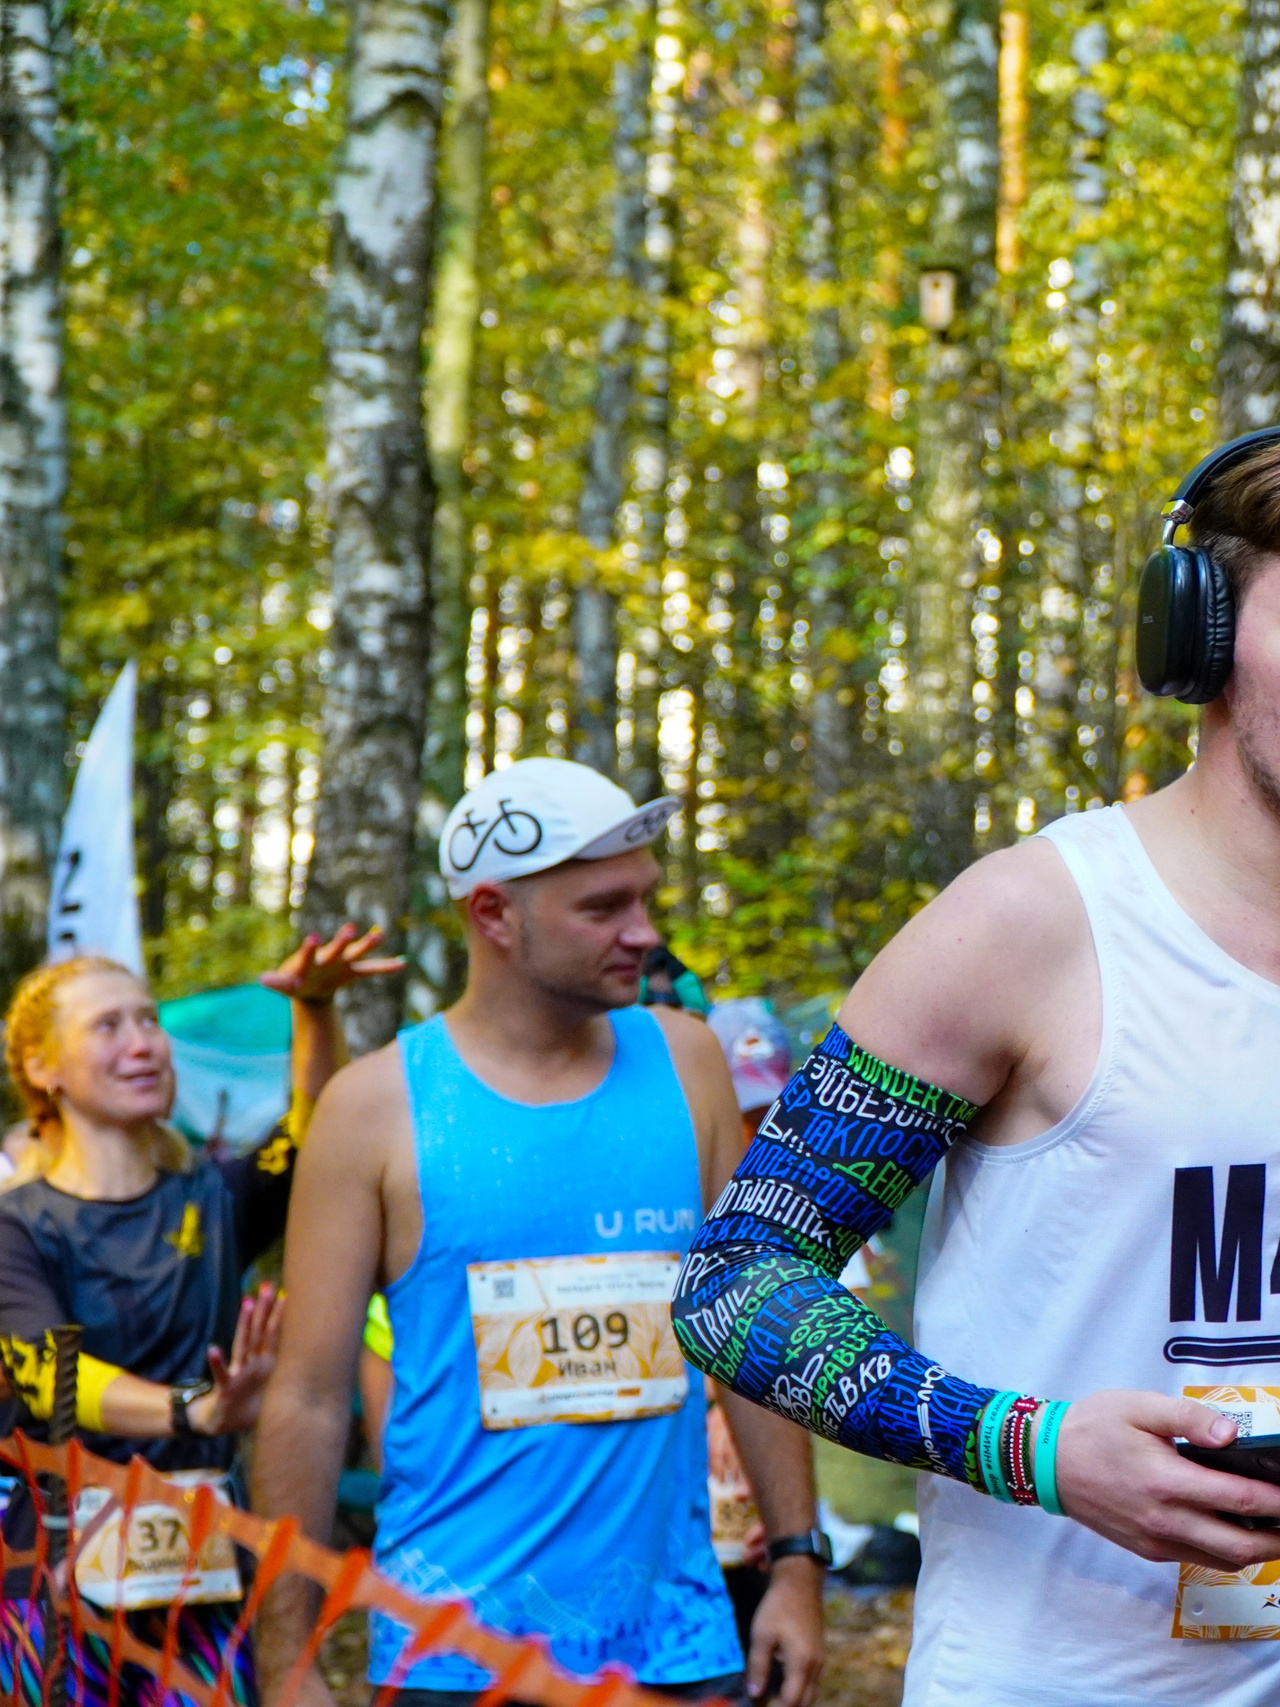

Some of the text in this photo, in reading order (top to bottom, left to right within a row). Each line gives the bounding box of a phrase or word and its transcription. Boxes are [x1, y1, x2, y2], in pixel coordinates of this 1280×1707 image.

[594, 1211, 623, 1238] U
[635, 1208, 696, 1234] RUN
[541, 1312, 630, 1354] 109
[136, 1519, 181, 1552] 37
